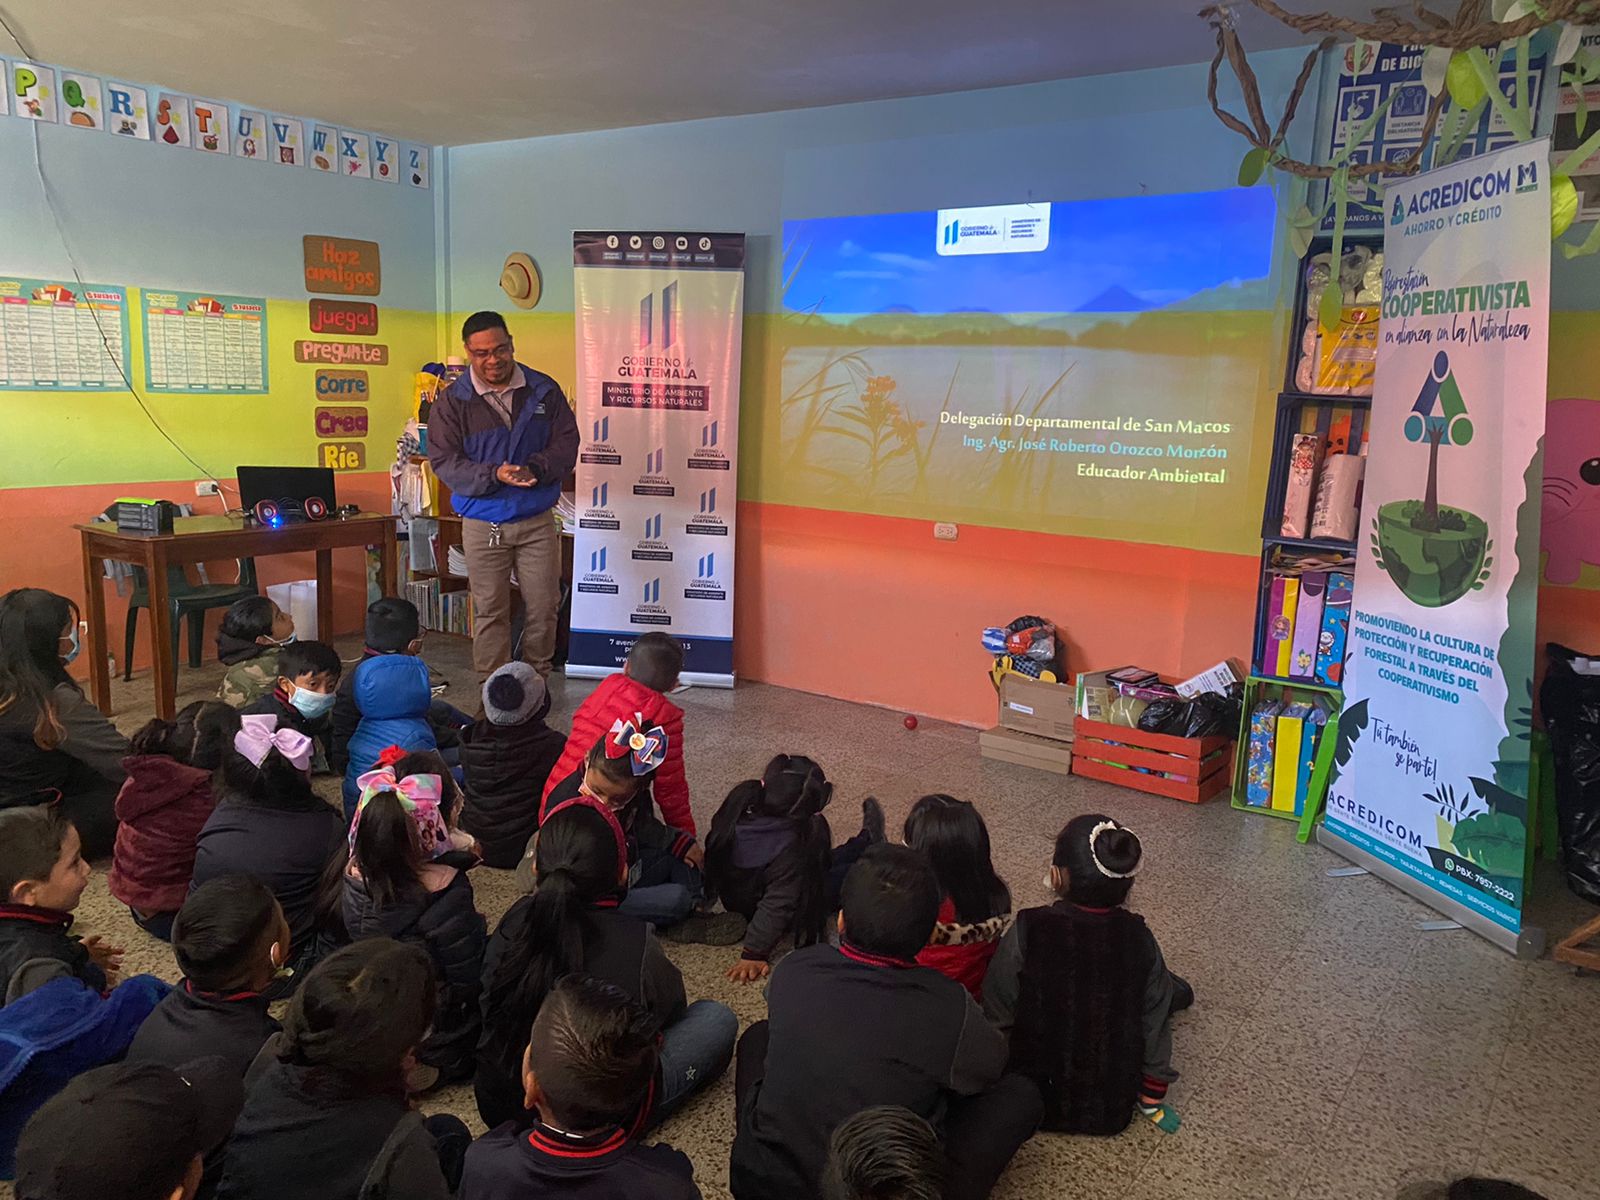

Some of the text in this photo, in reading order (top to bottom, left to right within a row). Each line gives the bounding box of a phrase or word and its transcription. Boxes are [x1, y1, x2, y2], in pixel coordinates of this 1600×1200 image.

[1381, 58, 1397, 72] DE
[15, 68, 419, 168] P Q R S T U V W X Y Z
[1407, 168, 1511, 216] ACREDICOM
[1404, 218, 1445, 237] AHORRO
[1456, 205, 1502, 226] CRÉDITO
[306, 263, 374, 292] amigos
[1382, 280, 1531, 319] COOPERATIVISTA
[1396, 319, 1432, 345] alianza
[1452, 314, 1468, 343] la
[1468, 310, 1531, 347] Naturaleza
[618, 366, 697, 380] GUATEMALA
[622, 356, 681, 367] GOBIERNO
[316, 376, 367, 394] Corre
[607, 386, 703, 398] MINISTERIO DE AMBIENTE
[617, 396, 657, 405] RECURSOS
[659, 398, 703, 406] NATURALES
[316, 411, 368, 434] Crea
[940, 411, 1231, 434] Delegación Departamental de San Macos
[324, 445, 359, 468] Ríe
[963, 435, 986, 452] Ing.
[990, 436, 1016, 453] Agr.
[1019, 438, 1046, 452] José
[1050, 439, 1106, 454] Roberto
[1110, 442, 1163, 456] Orozco
[1077, 463, 1146, 480] Educador
[1355, 610, 1495, 661] PROMOVIENDO LA CULTURA DE
[1354, 626, 1493, 679] PROTECCIÓN Y RECUPERACIÓN
[1364, 646, 1479, 692] FORESTAL A TRAVÉS DEL
[1378, 668, 1460, 704] COOPERATIVISMO
[1370, 716, 1420, 757] Tú también
[1395, 752, 1438, 785] se parte!
[1328, 790, 1422, 849] ACREDICOM
[1456, 864, 1474, 880] PBX:
